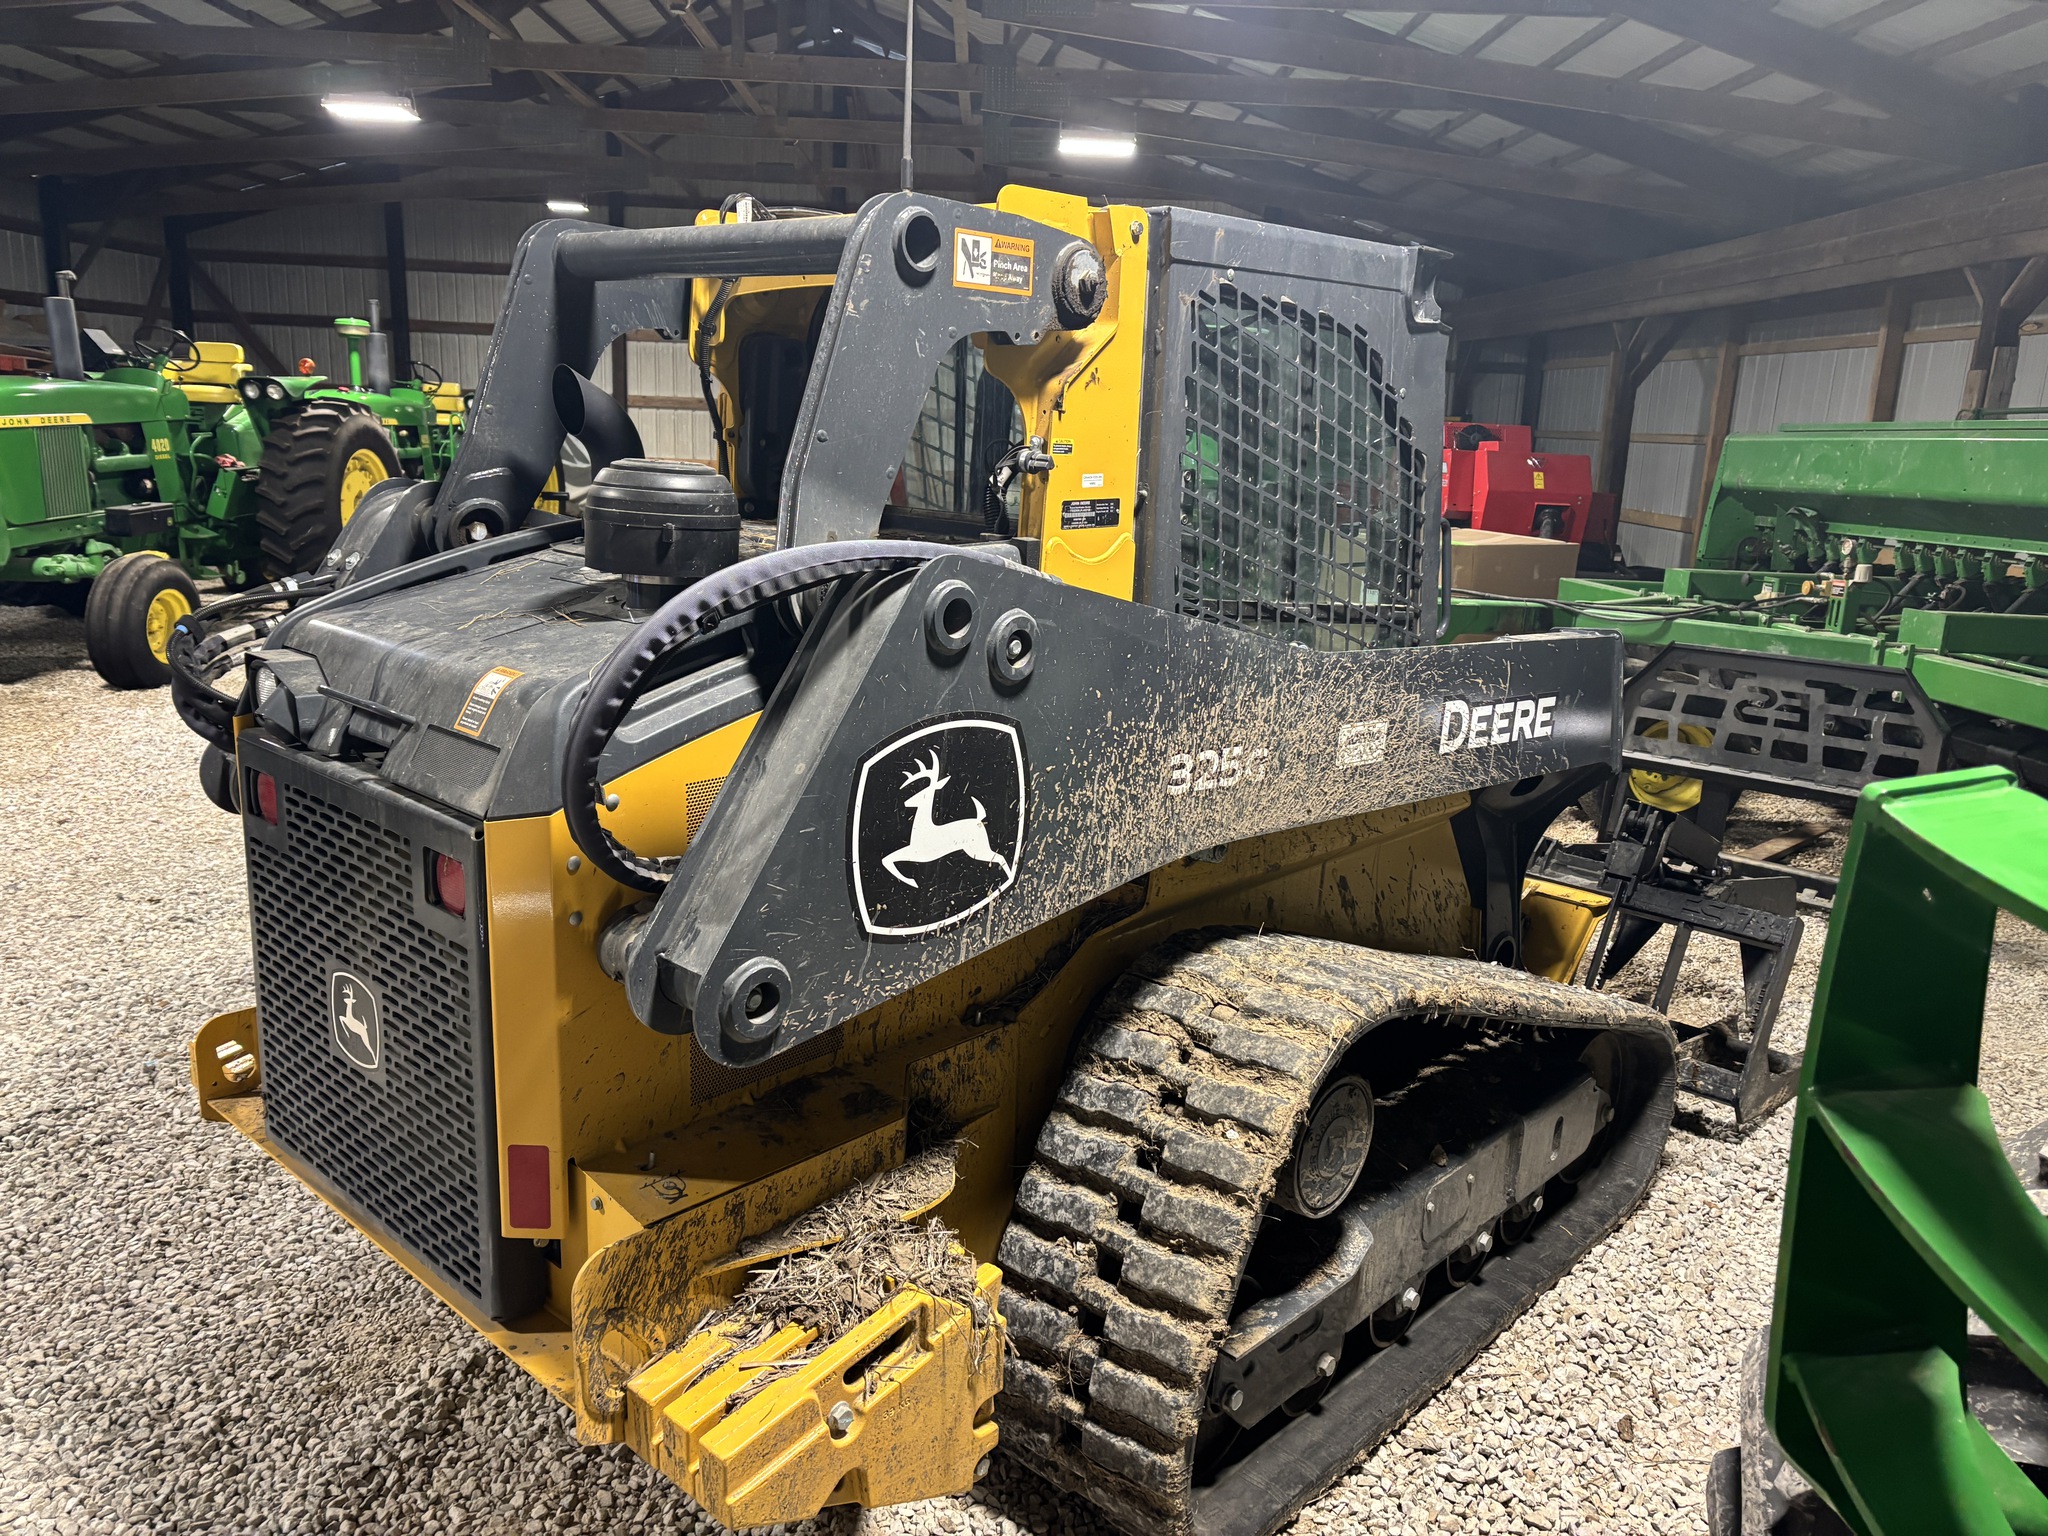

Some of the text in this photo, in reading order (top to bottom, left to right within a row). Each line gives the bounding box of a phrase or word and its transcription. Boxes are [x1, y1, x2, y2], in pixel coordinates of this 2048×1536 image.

[1001, 241, 1030, 253] WARNING
[993, 259, 1029, 273] Pinch Area
[2, 415, 71, 426] JOHN DEERE
[1438, 696, 1557, 755] DEERE
[819, 1370, 838, 1389] USA
